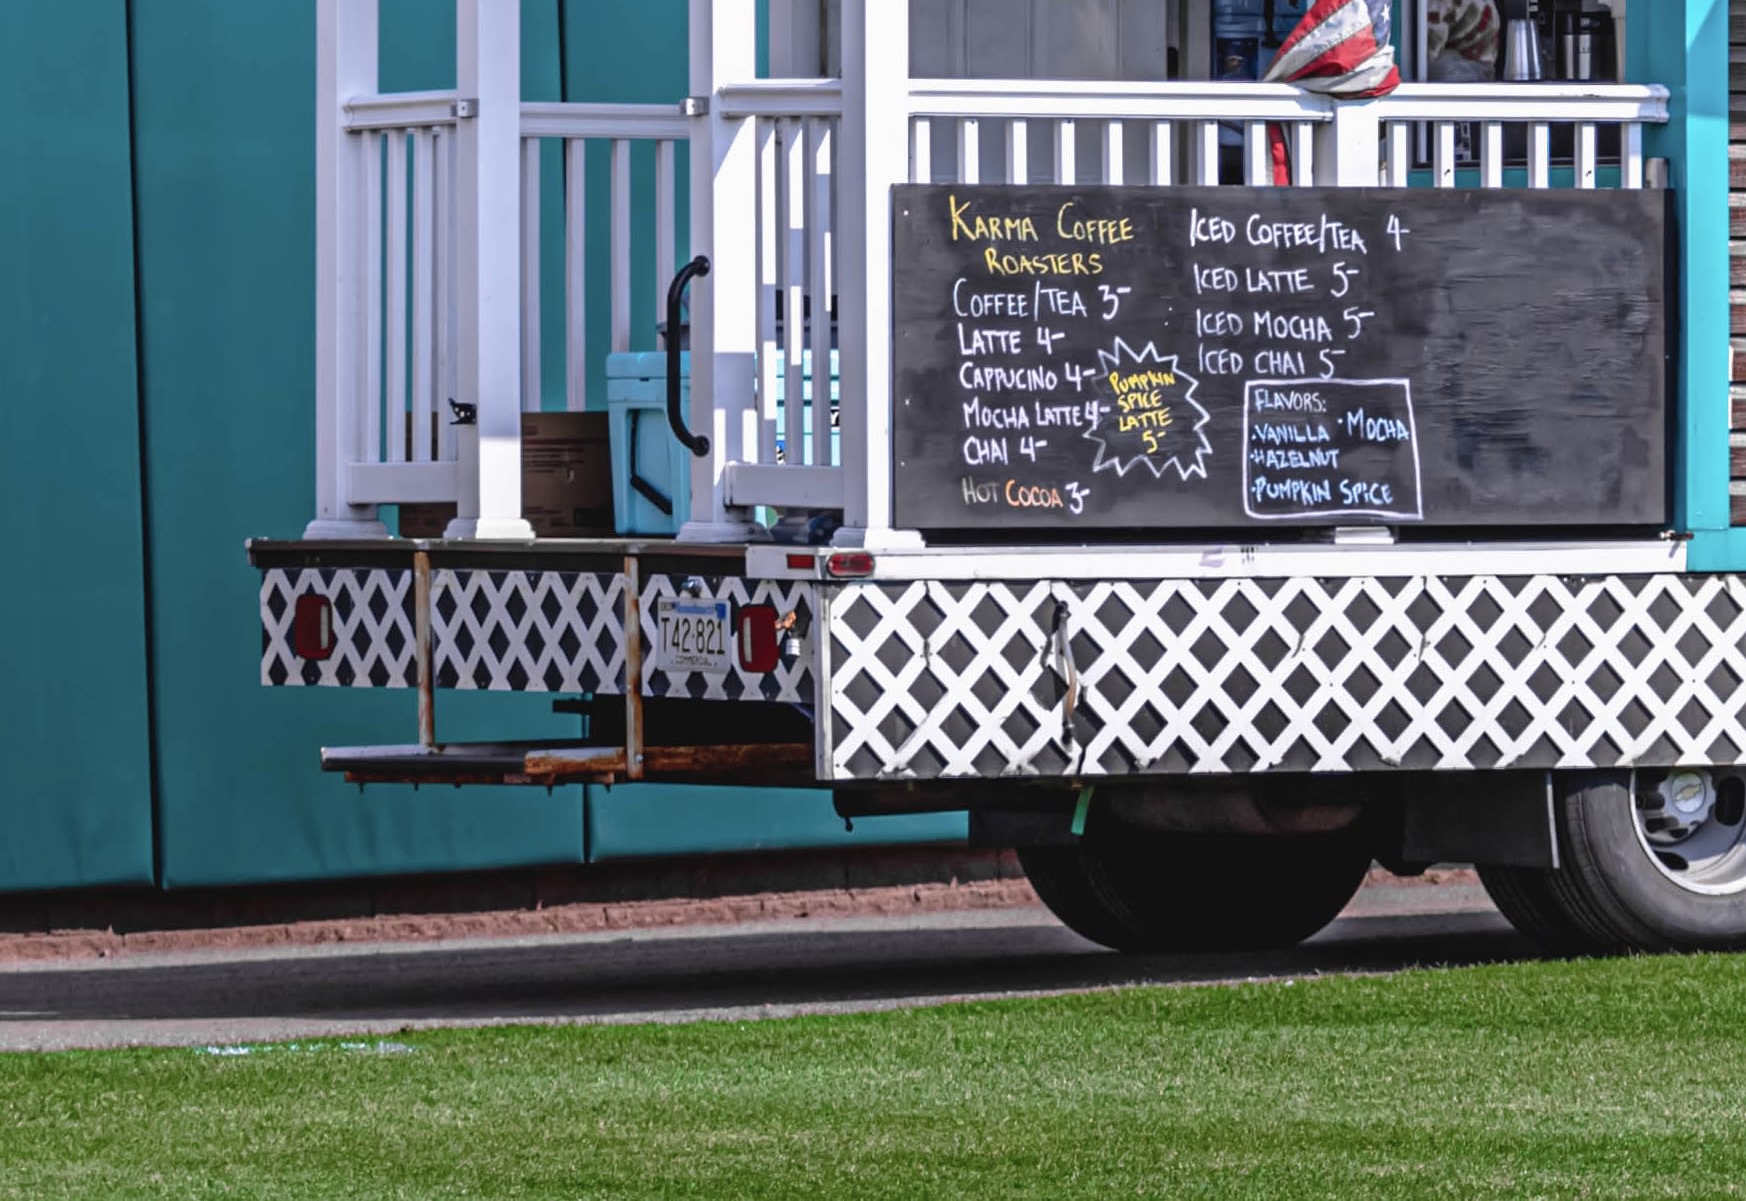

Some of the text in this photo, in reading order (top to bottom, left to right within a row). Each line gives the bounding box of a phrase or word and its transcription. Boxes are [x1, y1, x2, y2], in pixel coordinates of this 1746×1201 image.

[949, 195, 1134, 244] KARMA COFFEE
[1190, 208, 1236, 247] ICED
[1246, 213, 1368, 254] COFFEE/TEA
[985, 247, 1104, 276] ROASTERS
[1194, 263, 1238, 295] ICED
[1246, 267, 1315, 292] LATTE
[953, 278, 1087, 321] COFFEE/TEA
[957, 322, 1022, 356] LATTE
[1196, 308, 1243, 338] ICED
[1254, 310, 1333, 341] MOCHA
[1199, 343, 1243, 374] ICED
[1254, 351, 1305, 375] CHAI
[959, 361, 1058, 392] CAPPUCINO
[1109, 370, 1176, 395] PUMPKIN
[963, 396, 1030, 429] MOCHA
[1035, 400, 1082, 426] LATTE
[1116, 389, 1163, 414] SPICE
[1254, 388, 1328, 413] FLAVORS:
[1119, 407, 1174, 432] LATTE
[1256, 407, 1410, 446] VANILLA MOCHA
[963, 435, 1009, 466] CHAI
[1254, 447, 1340, 470] HAZELNUT
[962, 476, 999, 504] HOT
[1005, 479, 1064, 508] COCOA
[1255, 476, 1332, 507] PUMPKIN
